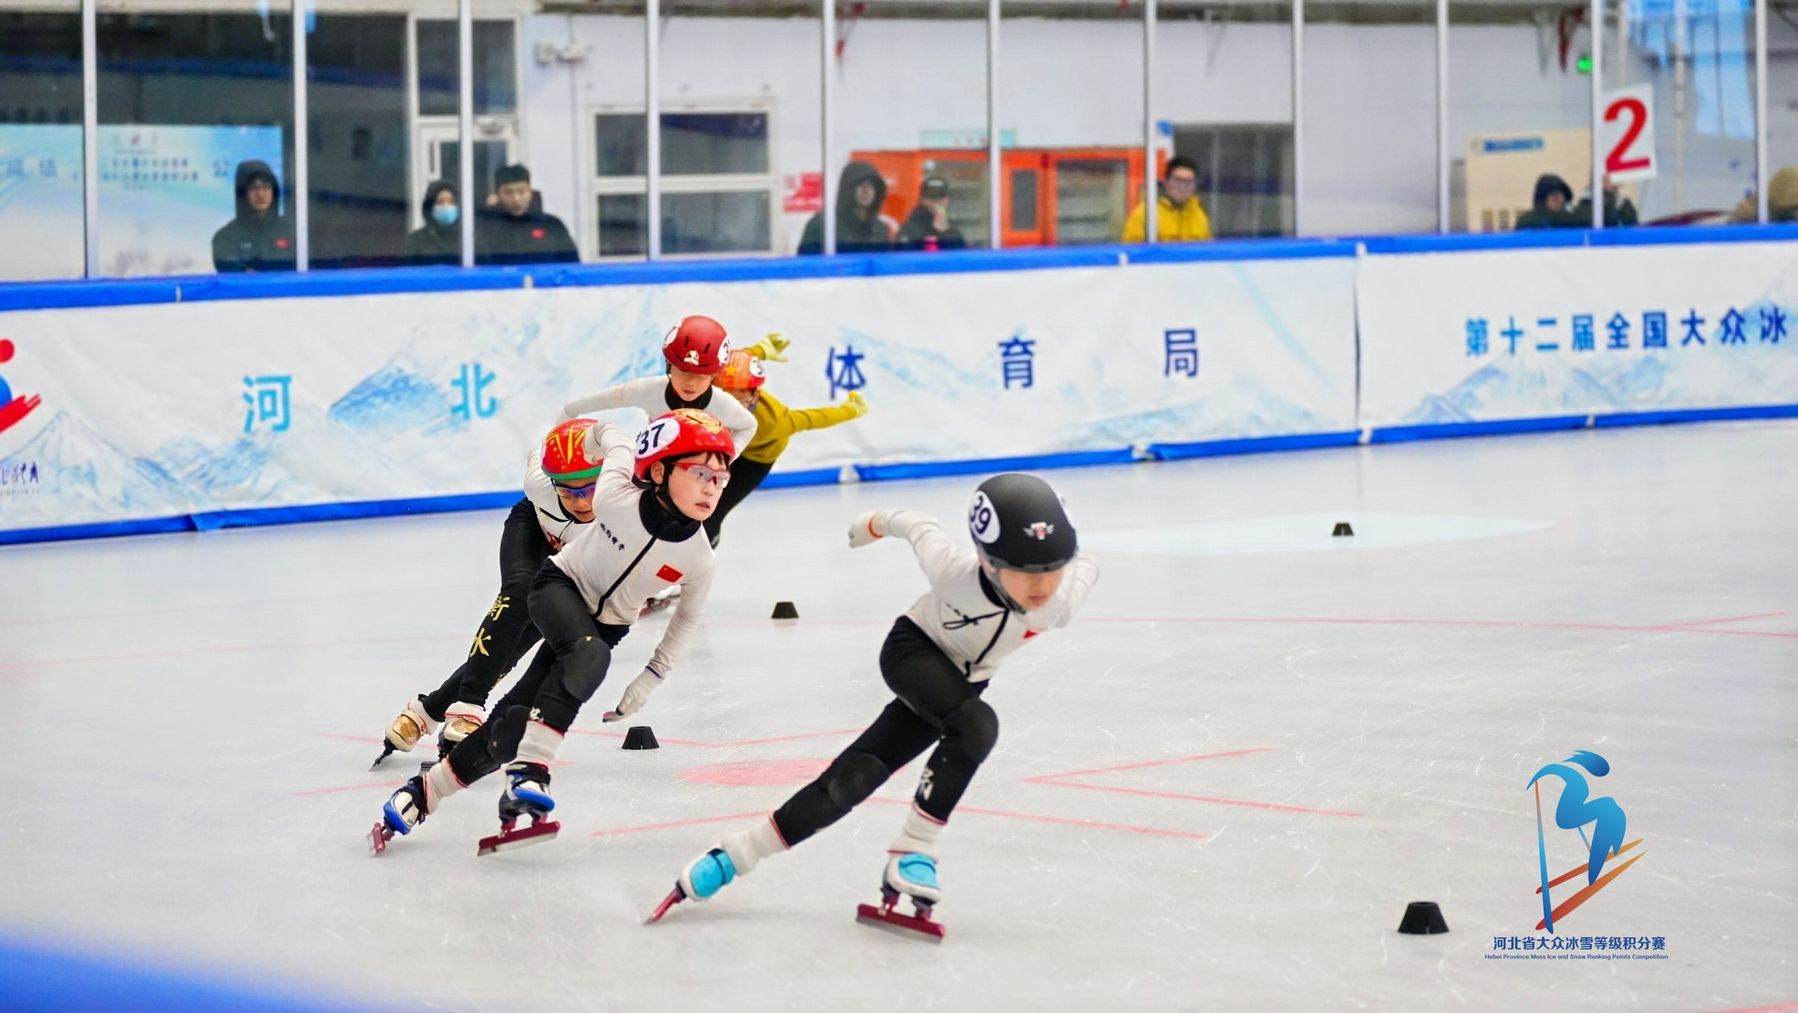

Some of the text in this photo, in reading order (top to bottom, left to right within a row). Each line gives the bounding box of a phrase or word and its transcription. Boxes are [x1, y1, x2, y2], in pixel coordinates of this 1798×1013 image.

[1604, 96, 1650, 172] 2
[1466, 307, 1788, 357] 第十二届全国大众冰
[970, 495, 991, 535] 39
